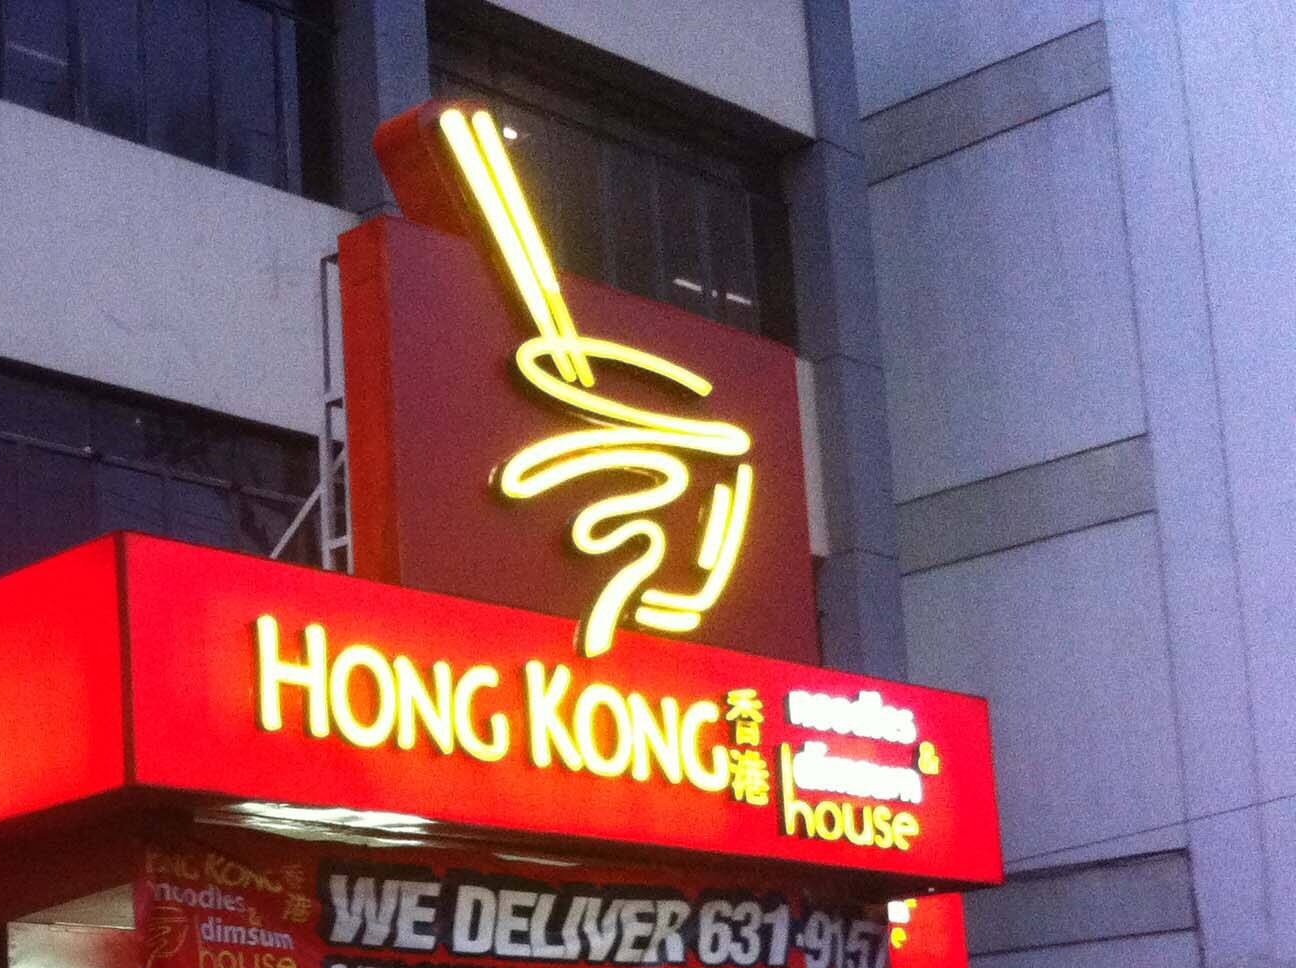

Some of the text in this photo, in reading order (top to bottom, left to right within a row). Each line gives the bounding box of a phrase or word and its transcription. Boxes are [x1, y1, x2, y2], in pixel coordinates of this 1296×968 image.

[256, 613, 510, 762] HONG
[525, 659, 731, 792] KONG
[781, 743, 920, 850] house
[200, 916, 295, 950] dimsum
[328, 874, 441, 951] WE
[453, 885, 690, 963] DELIVER
